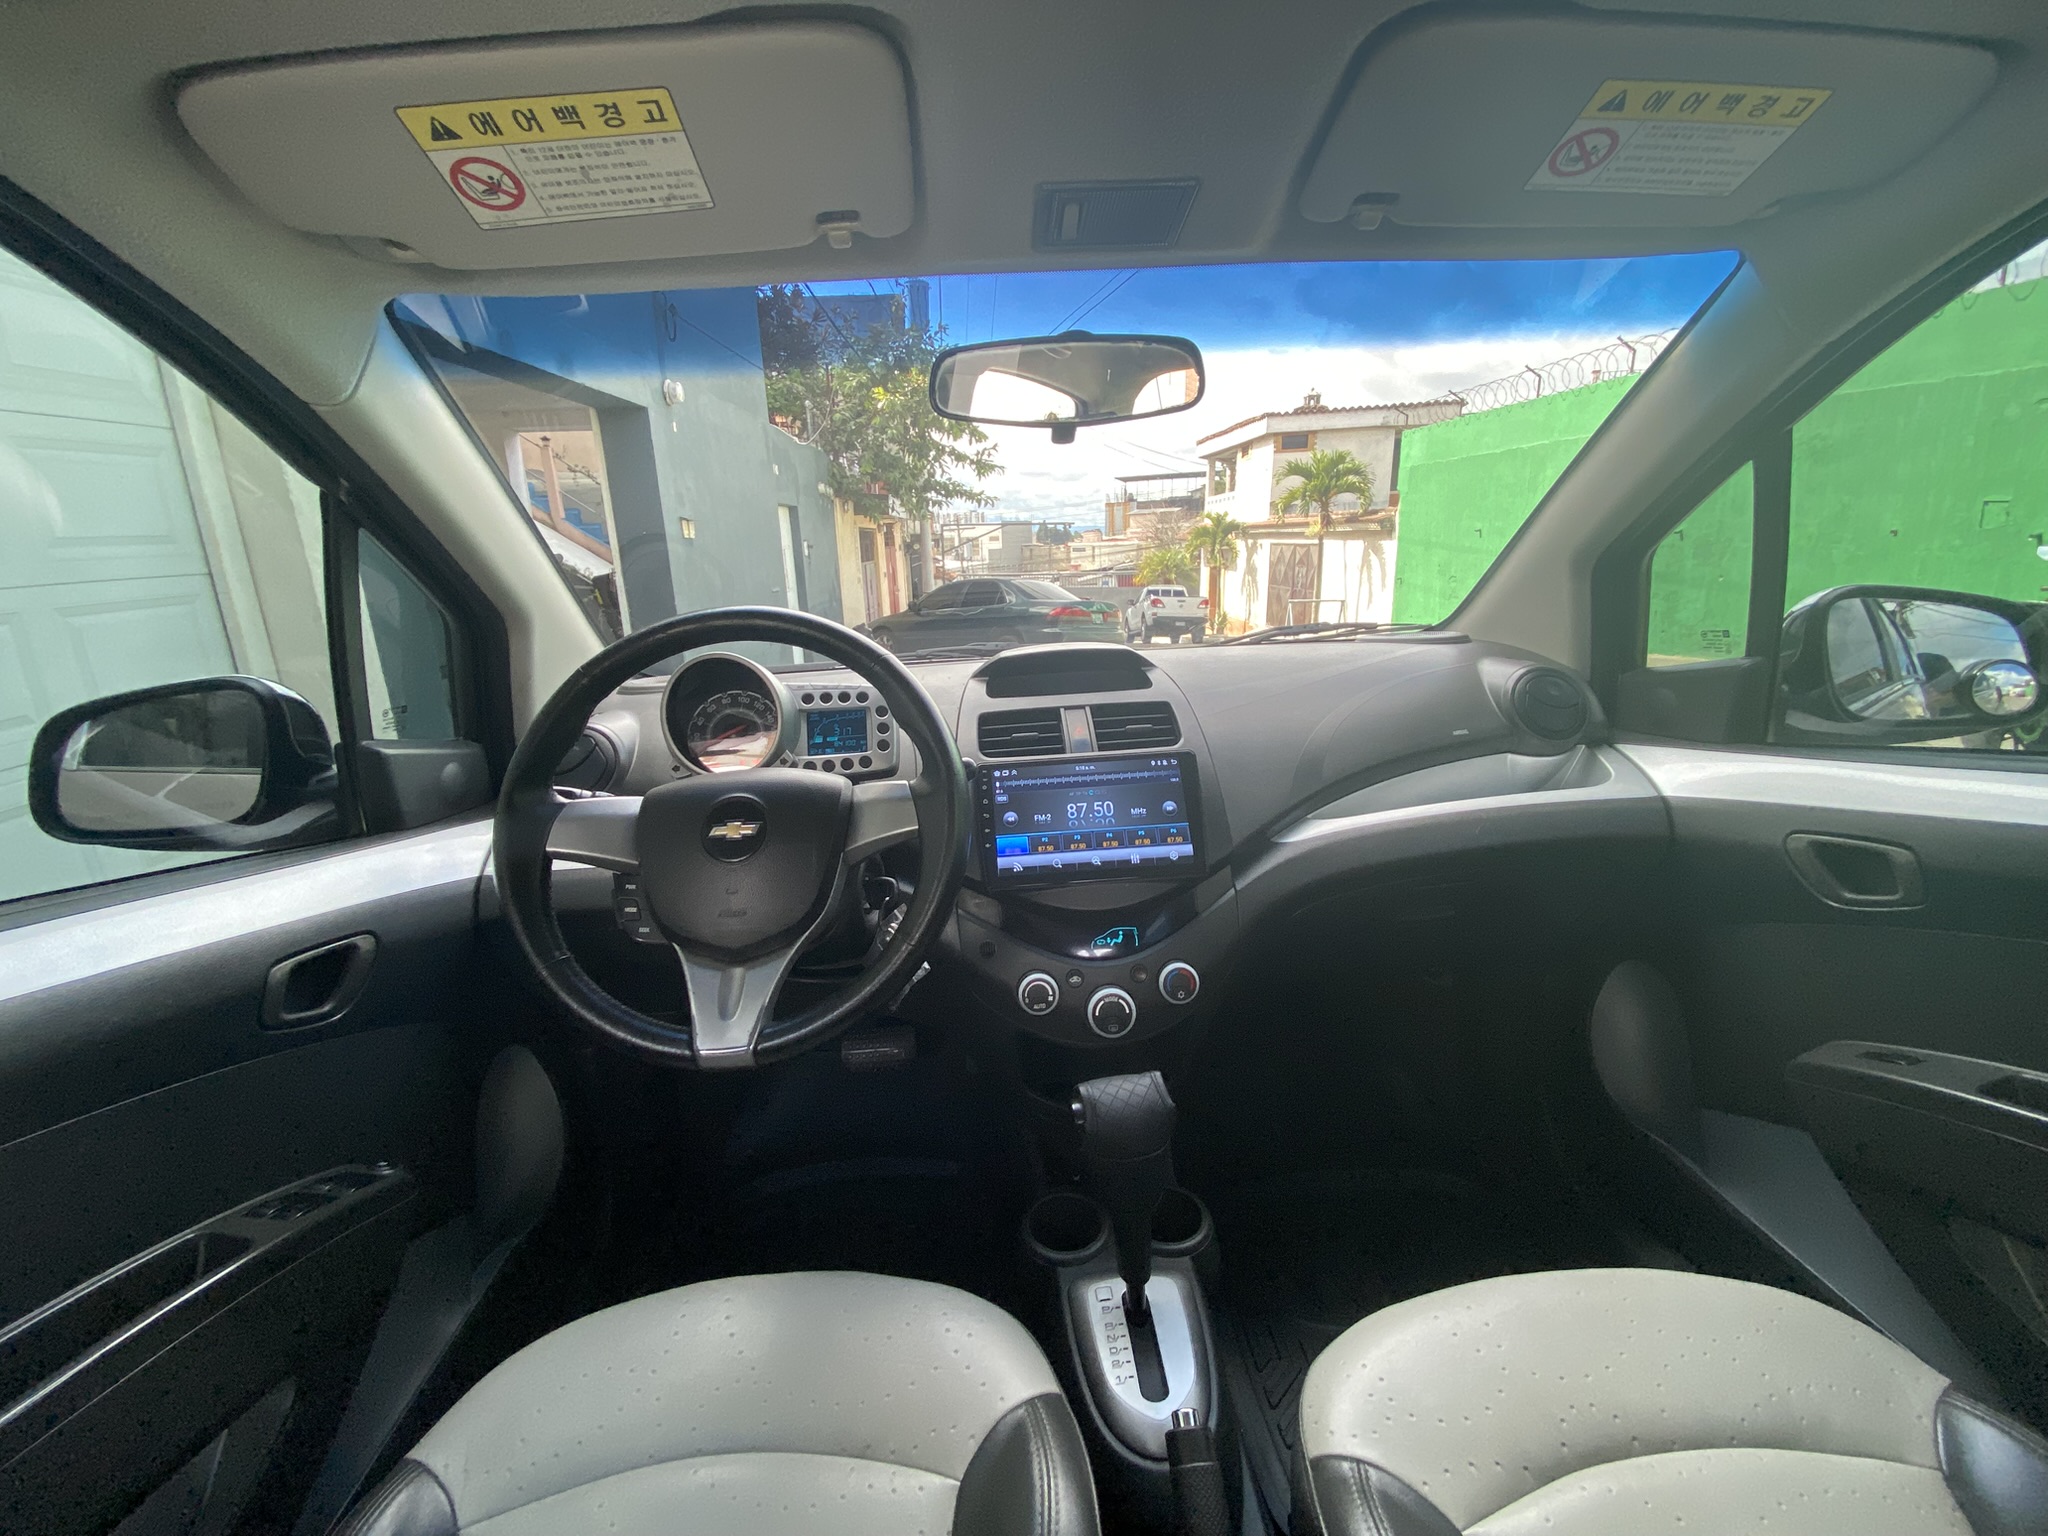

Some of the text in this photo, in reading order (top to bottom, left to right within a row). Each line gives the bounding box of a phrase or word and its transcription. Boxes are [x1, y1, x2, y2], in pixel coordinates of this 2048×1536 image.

[738, 696, 750, 704] 100
[753, 701, 766, 711] 120
[1066, 800, 1114, 819] 87.50
[1130, 807, 1147, 816] MHz
